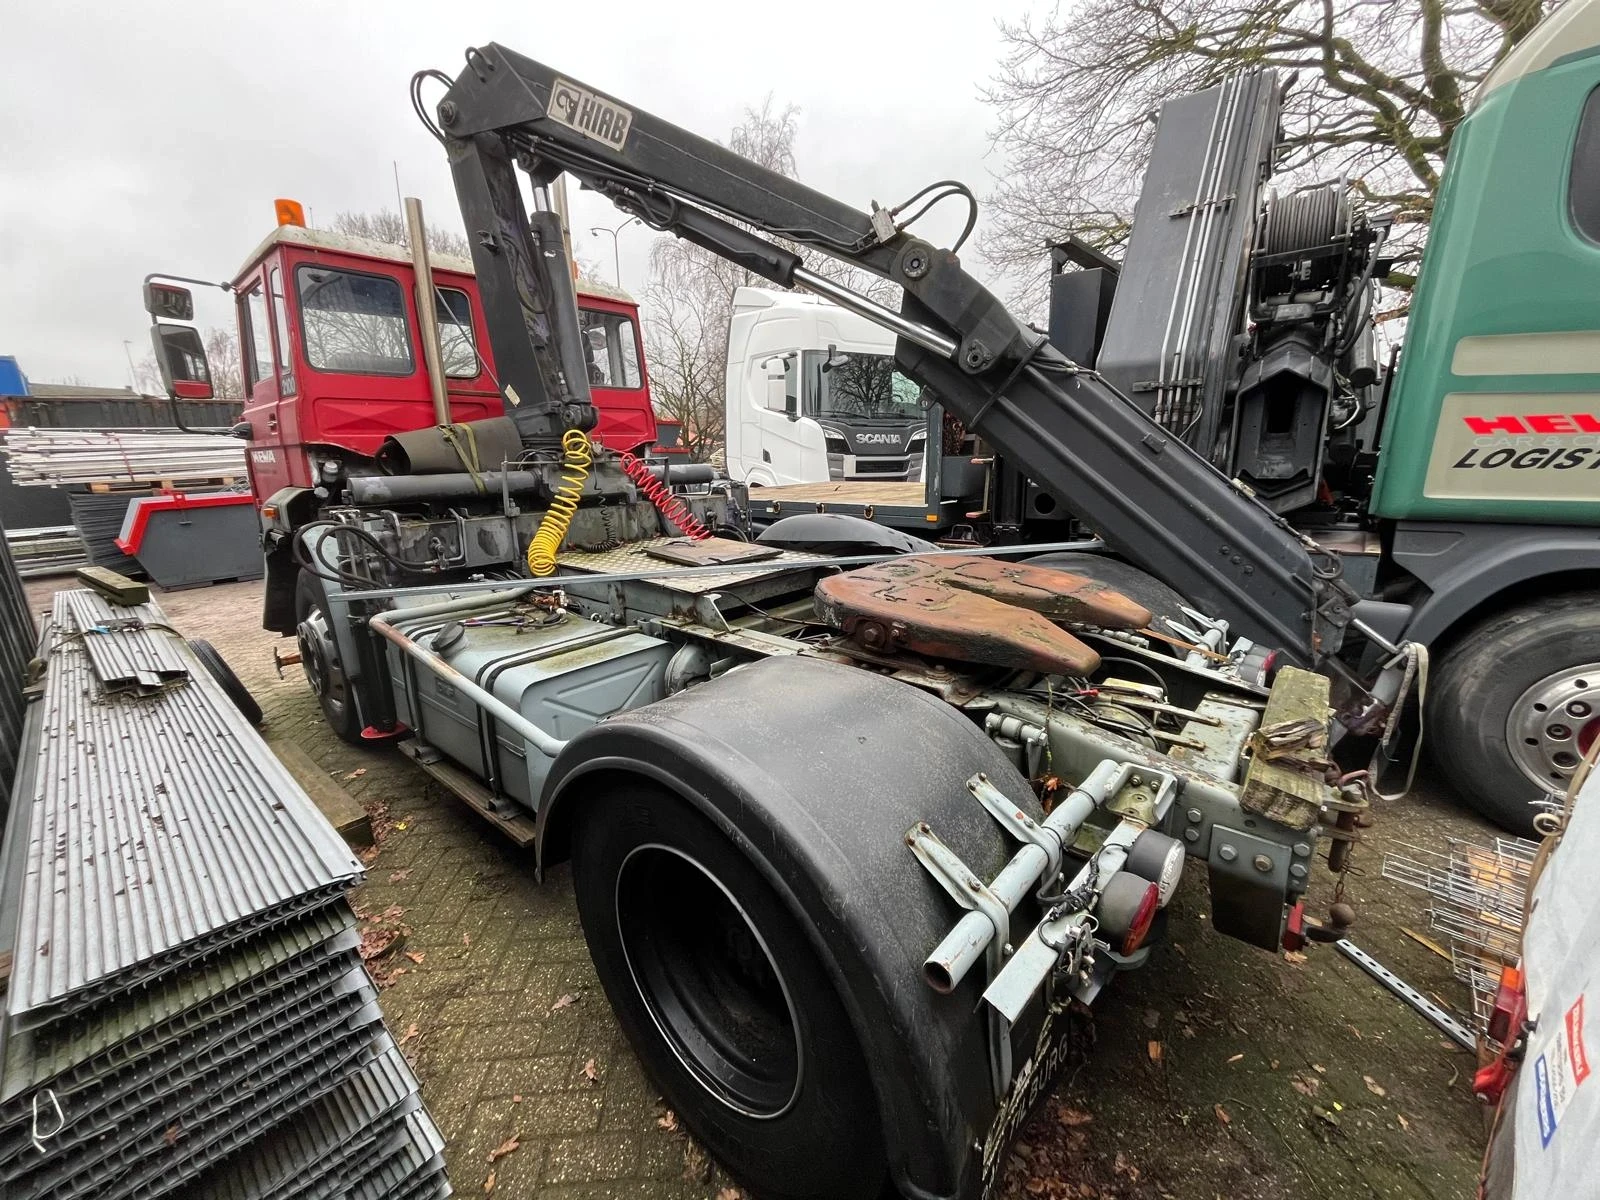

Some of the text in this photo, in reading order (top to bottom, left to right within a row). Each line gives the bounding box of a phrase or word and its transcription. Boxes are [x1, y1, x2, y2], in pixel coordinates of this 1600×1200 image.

[579, 98, 628, 144] HIAB
[855, 433, 902, 444] SCANIA
[1473, 437, 1535, 447] CAR
[1543, 436, 1563, 446] &
